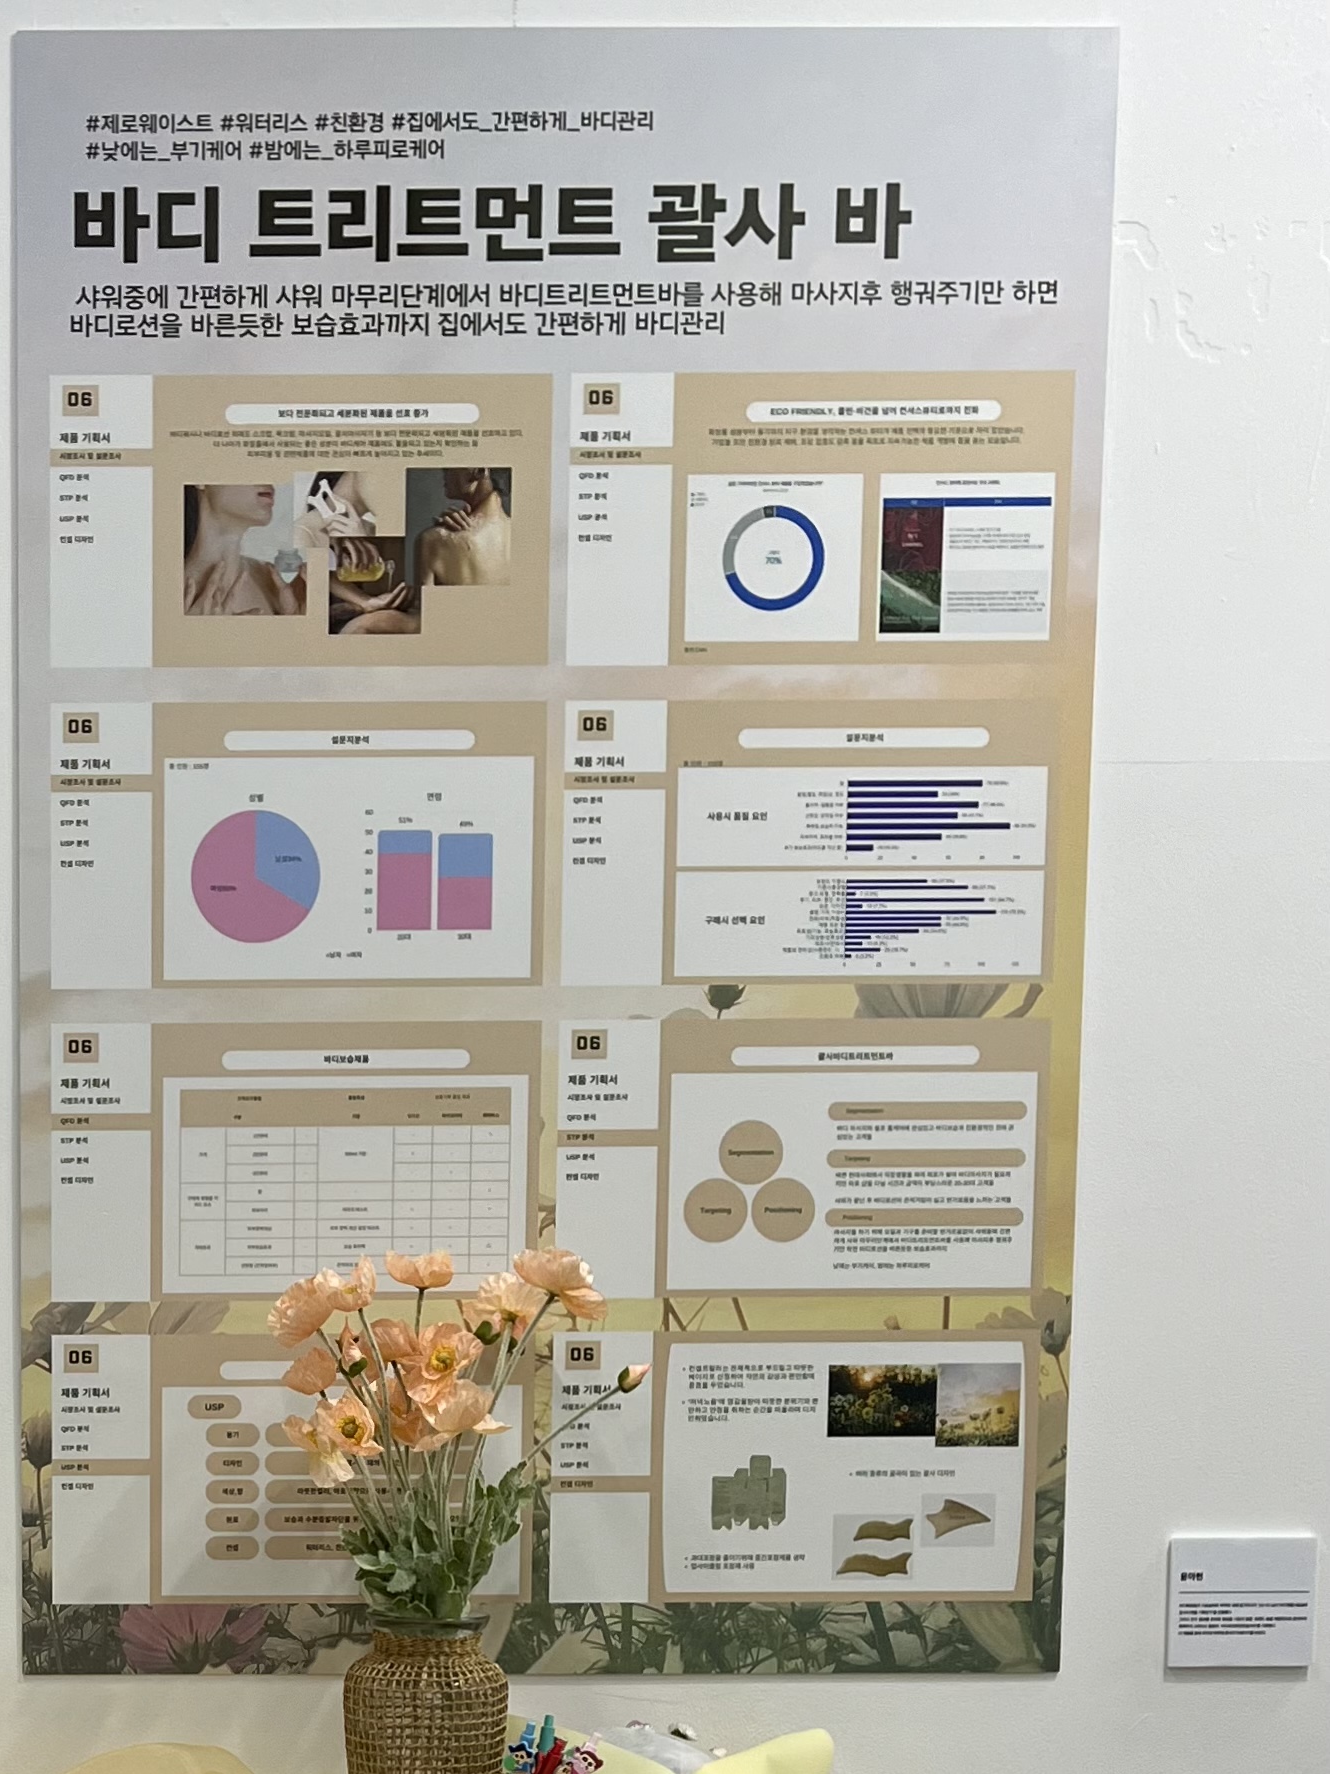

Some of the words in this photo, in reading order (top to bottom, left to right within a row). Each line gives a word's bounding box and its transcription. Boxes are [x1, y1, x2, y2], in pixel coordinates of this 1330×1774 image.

[85, 113, 214, 134] #제로웨이스트
[219, 112, 308, 133] #워터리스
[314, 111, 383, 133] #친환경
[391, 110, 653, 132] #집에서도_간편하게_바디관리
[85, 140, 241, 162] #낮에는_부기케어
[249, 138, 444, 161] #밤에는_하루피로케어
[73, 185, 219, 264] 바디
[248, 183, 620, 263] 트리트먼트
[648, 182, 805, 263] 괄사
[835, 182, 912, 259] 바
[70, 311, 182, 338] 바디로션을
[191, 312, 284, 338] 바른듯한
[290, 311, 429, 337] 보습효과까지
[437, 311, 527, 337] 집에서도
[534, 311, 626, 336] 간편하게
[635, 310, 724, 335] 바디관리
[67, 391, 92, 406] 06
[588, 389, 613, 405] 06
[59, 432, 78, 443] 제품
[81, 432, 110, 443] 기획서
[579, 430, 598, 442] 제품
[602, 430, 631, 441] 기획서
[68, 718, 92, 733] 06
[582, 716, 606, 731] 06
[331, 735, 369, 744] 설문지분석
[846, 733, 884, 742] 설문지분석
[752, 811, 767, 821] 요인
[68, 1039, 92, 1053] 06
[576, 1035, 600, 1050] 06
[323, 1054, 369, 1064] 바디보습제품
[68, 1350, 92, 1364] 06
[570, 1346, 594, 1361] 06
[60, 1387, 79, 1398] 제품
[82, 1387, 110, 1398] 기획서
[204, 1403, 224, 1411] USP
